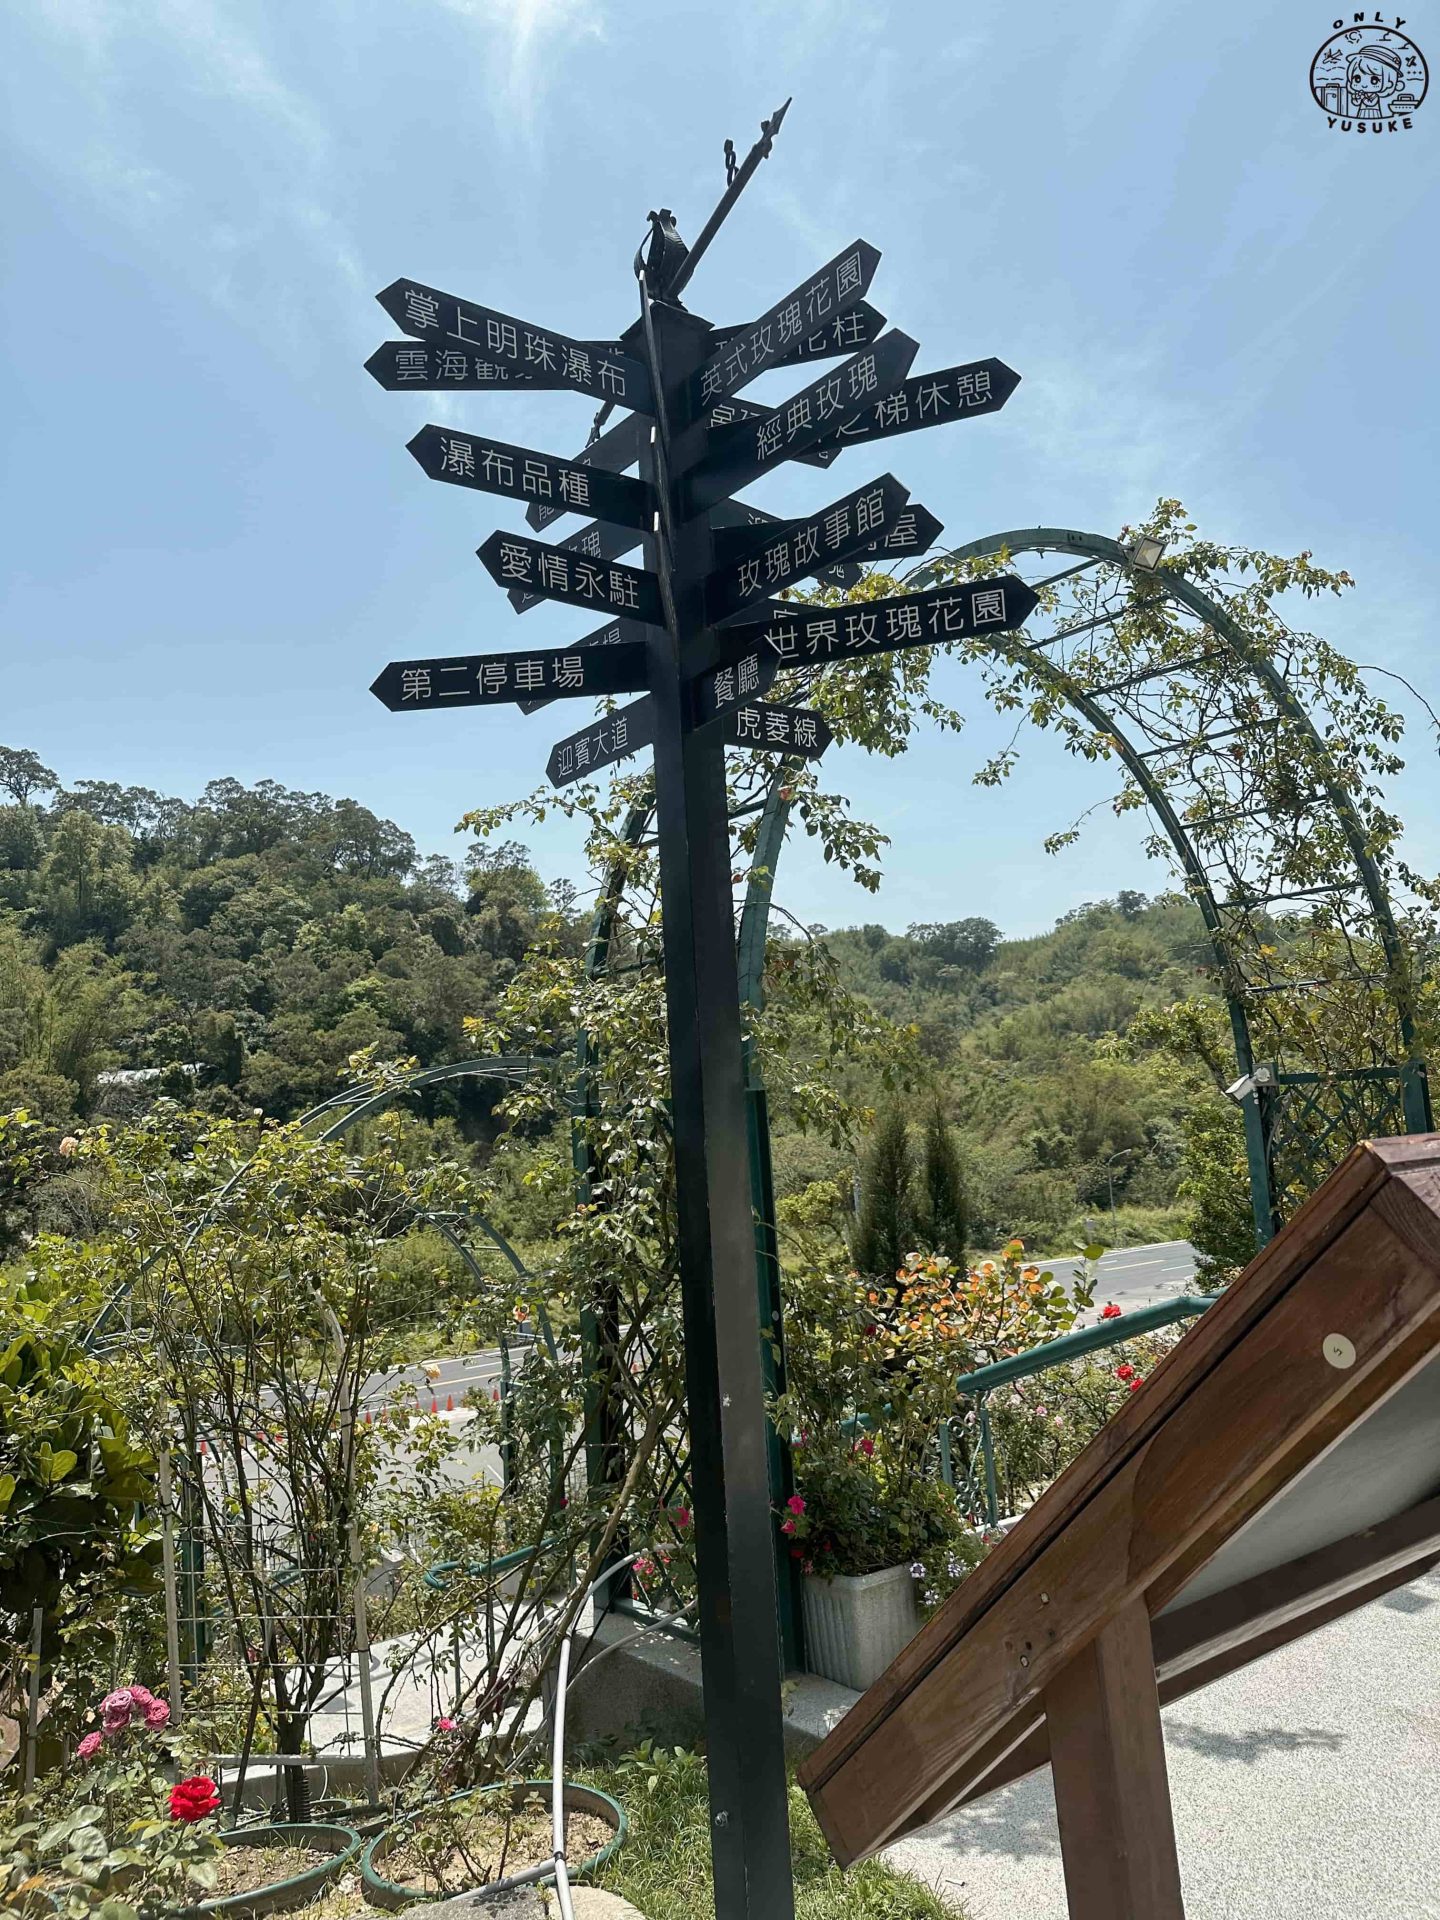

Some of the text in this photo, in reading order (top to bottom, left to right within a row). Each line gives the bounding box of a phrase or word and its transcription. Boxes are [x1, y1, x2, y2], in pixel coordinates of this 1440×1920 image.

[404, 289, 626, 397] 掌上明珠瀑布
[700, 250, 862, 407] 英式玫瑰花園
[756, 353, 878, 461] 經典玫瑰
[440, 436, 591, 508] 瀑布品種
[500, 541, 640, 609] 愛情永駐
[737, 488, 885, 598] 玫瑰故事館
[768, 589, 1008, 660] 世界玫瑰花園
[400, 655, 585, 702] 第二停車場
[713, 652, 760, 710] 餐廳
[557, 715, 629, 779] 迎賓大道
[736, 706, 818, 748] 虎菱線
